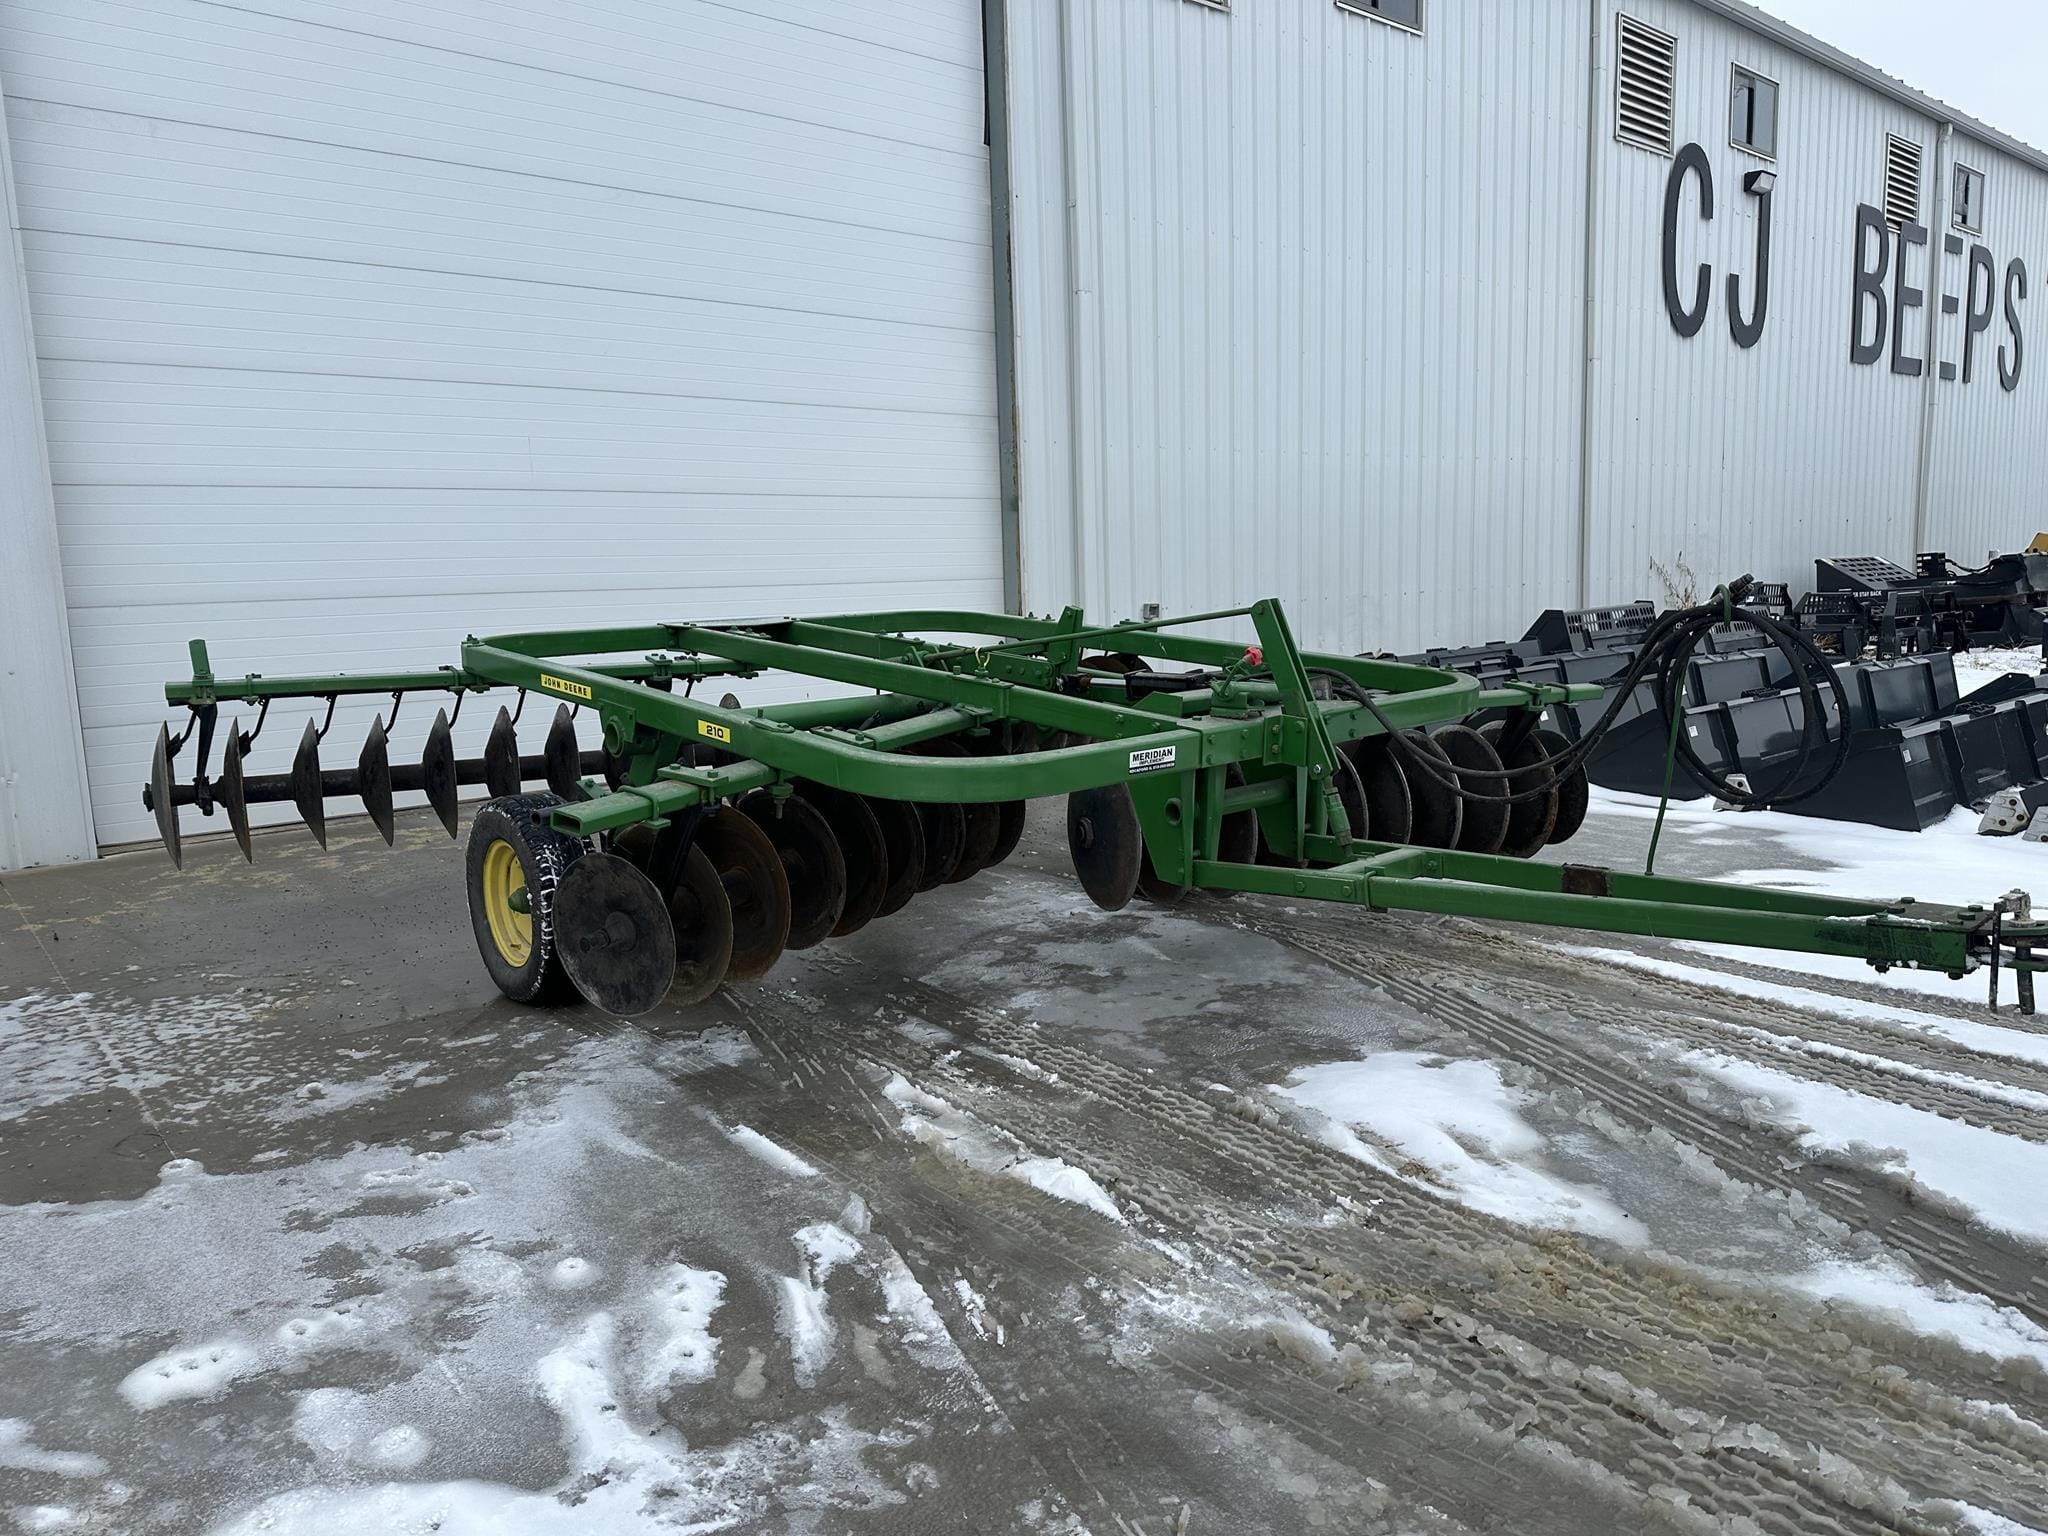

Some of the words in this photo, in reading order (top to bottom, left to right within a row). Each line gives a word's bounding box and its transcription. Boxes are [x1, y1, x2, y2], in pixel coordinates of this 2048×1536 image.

[543, 675, 561, 689] JOHN
[564, 682, 587, 696] DEERE
[706, 725, 724, 739] 210
[1132, 747, 1173, 762] MERIDIAN
